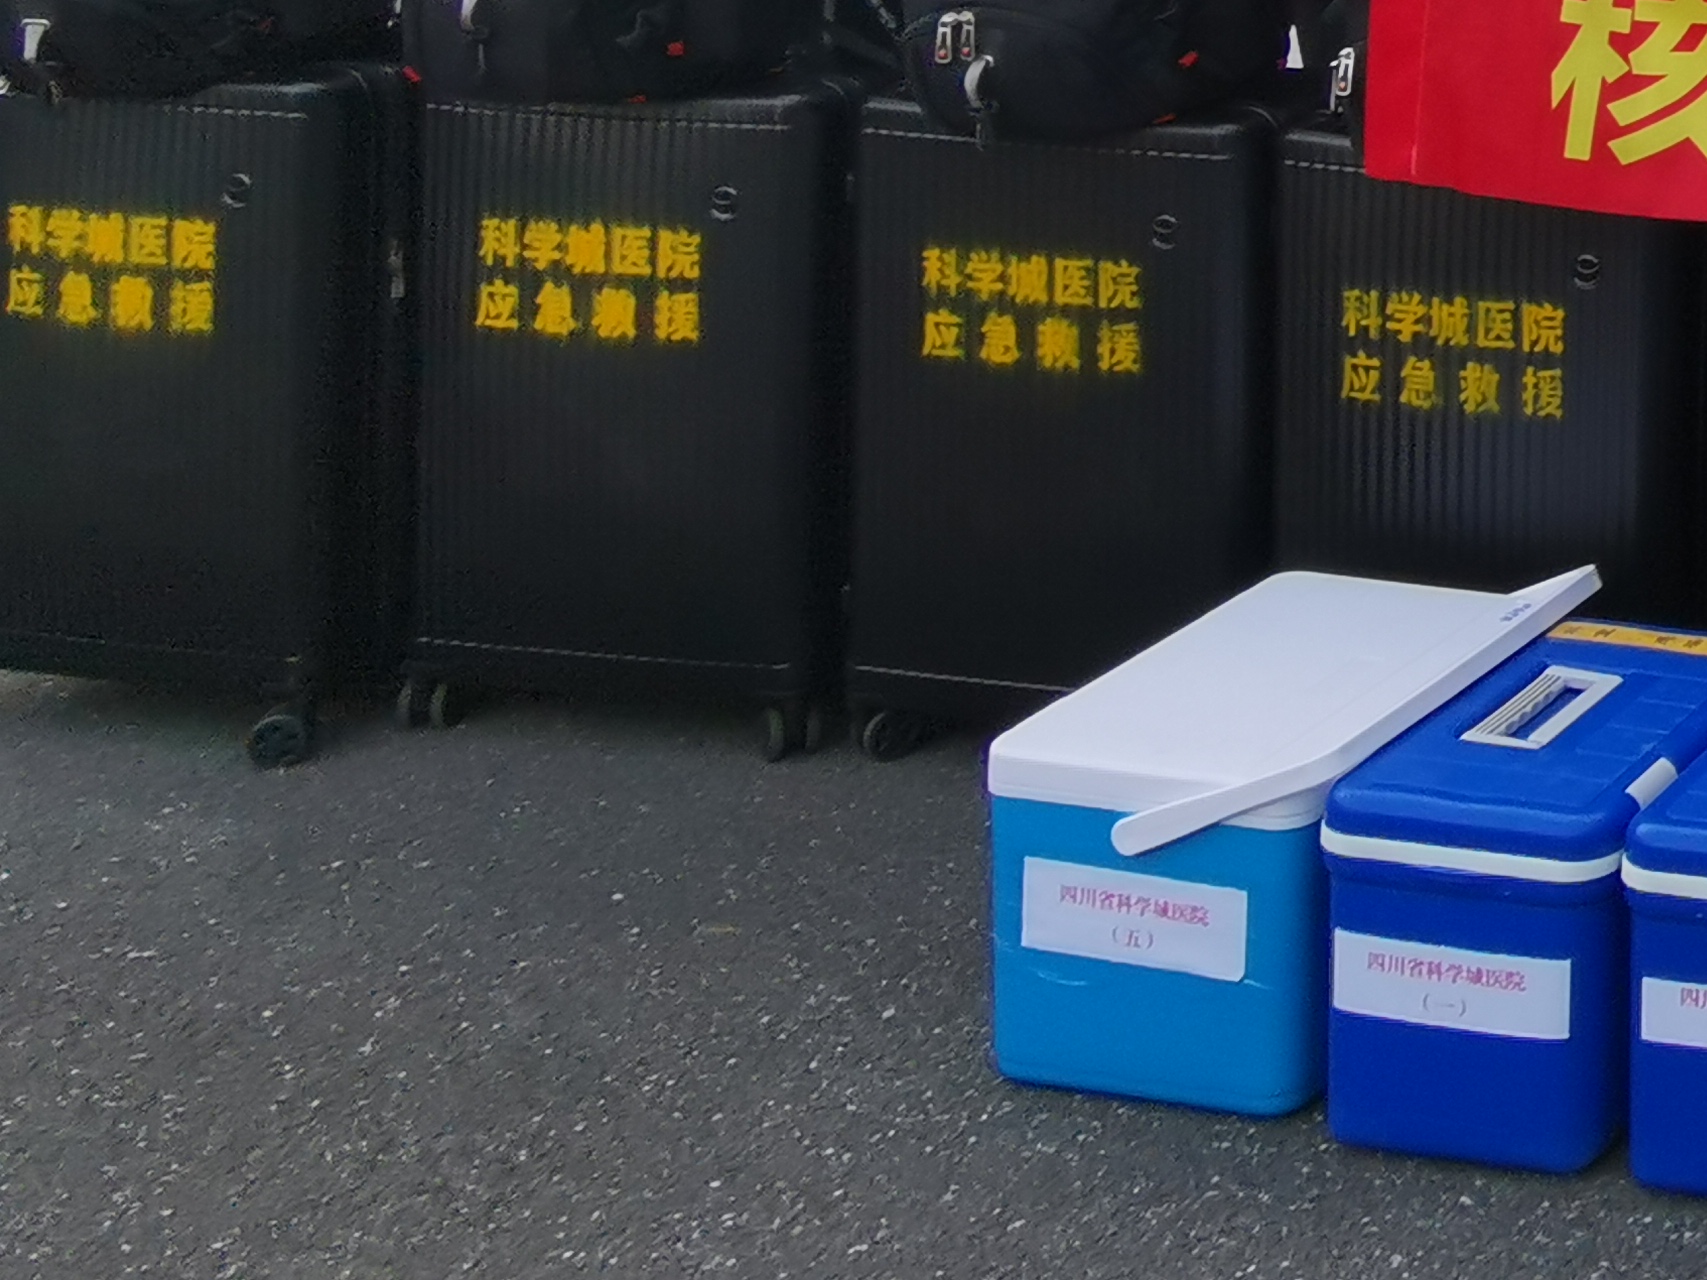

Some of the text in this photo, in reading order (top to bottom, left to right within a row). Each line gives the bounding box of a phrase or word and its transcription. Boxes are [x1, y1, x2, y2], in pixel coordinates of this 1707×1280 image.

[8, 205, 216, 272] 科学城医院
[480, 218, 701, 281] 科学城医院
[6, 267, 214, 334] 应急救援
[923, 248, 1140, 308] 科学城医院
[475, 279, 700, 342] 应急救援
[922, 309, 1139, 372] 应急救援
[1344, 290, 1565, 354] 科学城医院
[1343, 353, 1561, 416] 应急救援
[1060, 885, 1210, 927] 四川省科学城医院
[1367, 951, 1526, 991] 四川省科学城医院
